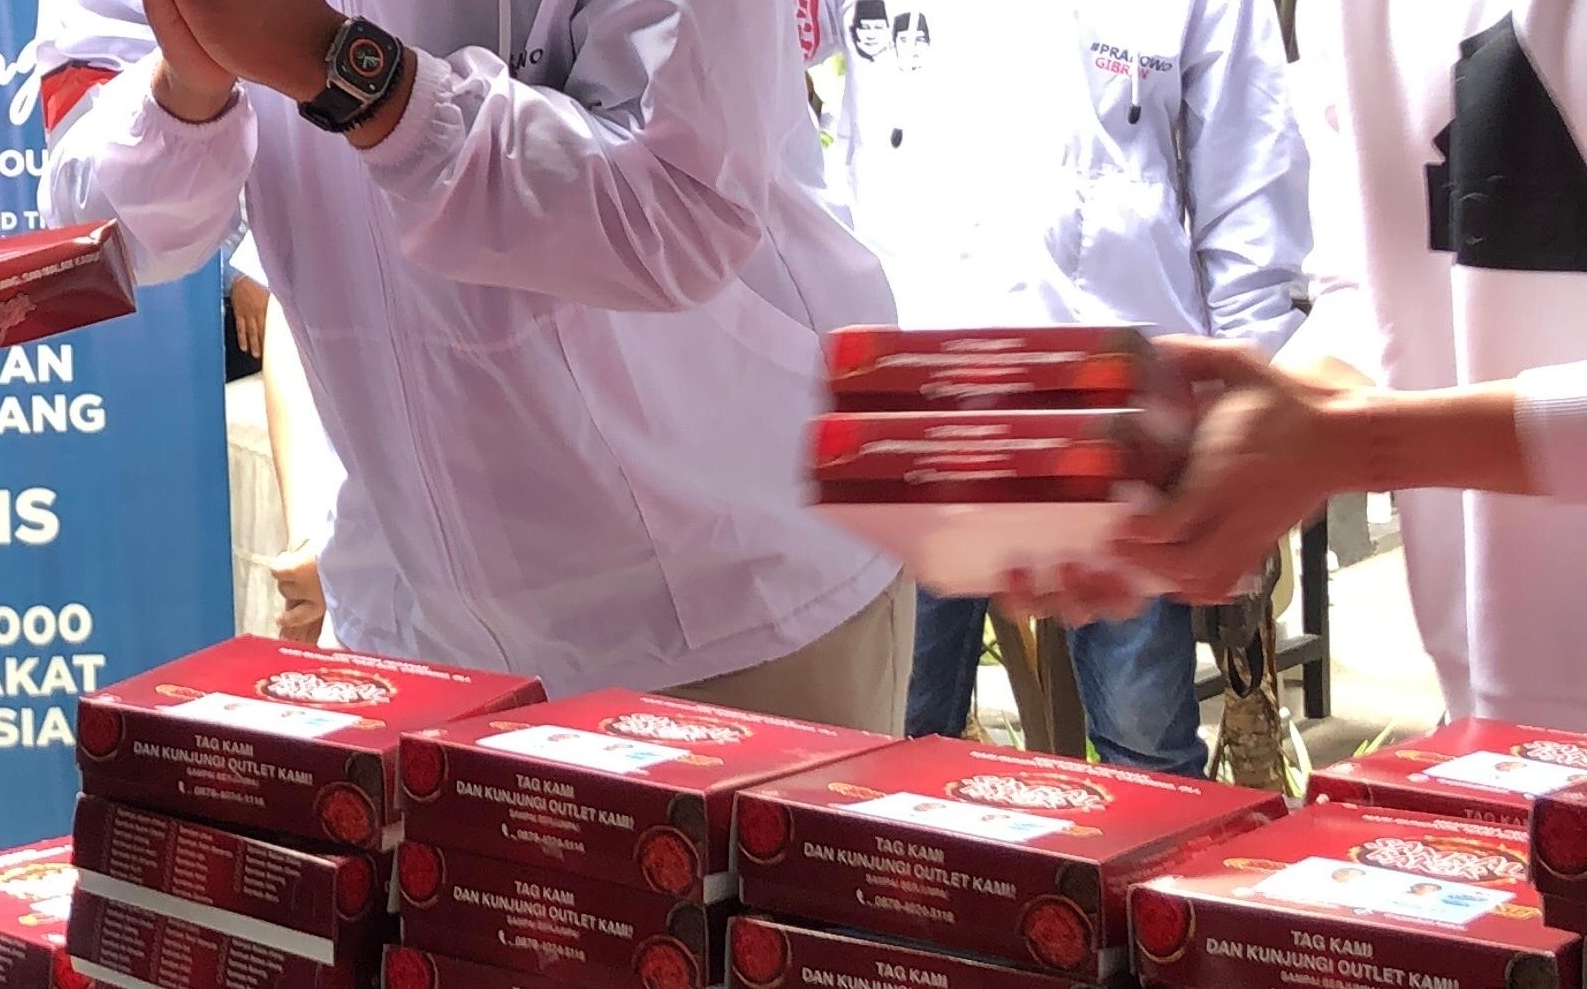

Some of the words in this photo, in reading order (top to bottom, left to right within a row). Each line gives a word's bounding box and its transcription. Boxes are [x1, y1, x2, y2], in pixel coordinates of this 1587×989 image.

[456, 779, 483, 799] DAN
[484, 785, 547, 812] KUNJUNGI
[548, 799, 597, 823] OUTLET
[515, 773, 541, 793] TAG
[543, 779, 575, 799] KAMI
[874, 835, 906, 856] TAG
[908, 841, 945, 865] KAMI
[803, 841, 835, 862] DAN
[837, 848, 912, 876] KUNJUNGI
[913, 865, 970, 891] OUTLET
[452, 885, 480, 905] DAN
[481, 892, 547, 918] KUNJUNGI
[548, 905, 597, 929] OUTLET
[514, 880, 541, 900] TAG
[542, 885, 575, 907] KAMI
[1290, 929, 1326, 952] TAG
[801, 966, 835, 987] DAN
[1205, 937, 1243, 959] DAN
[1246, 944, 1335, 976] KUNJUNGI
[1337, 959, 1405, 988] OUTLET
